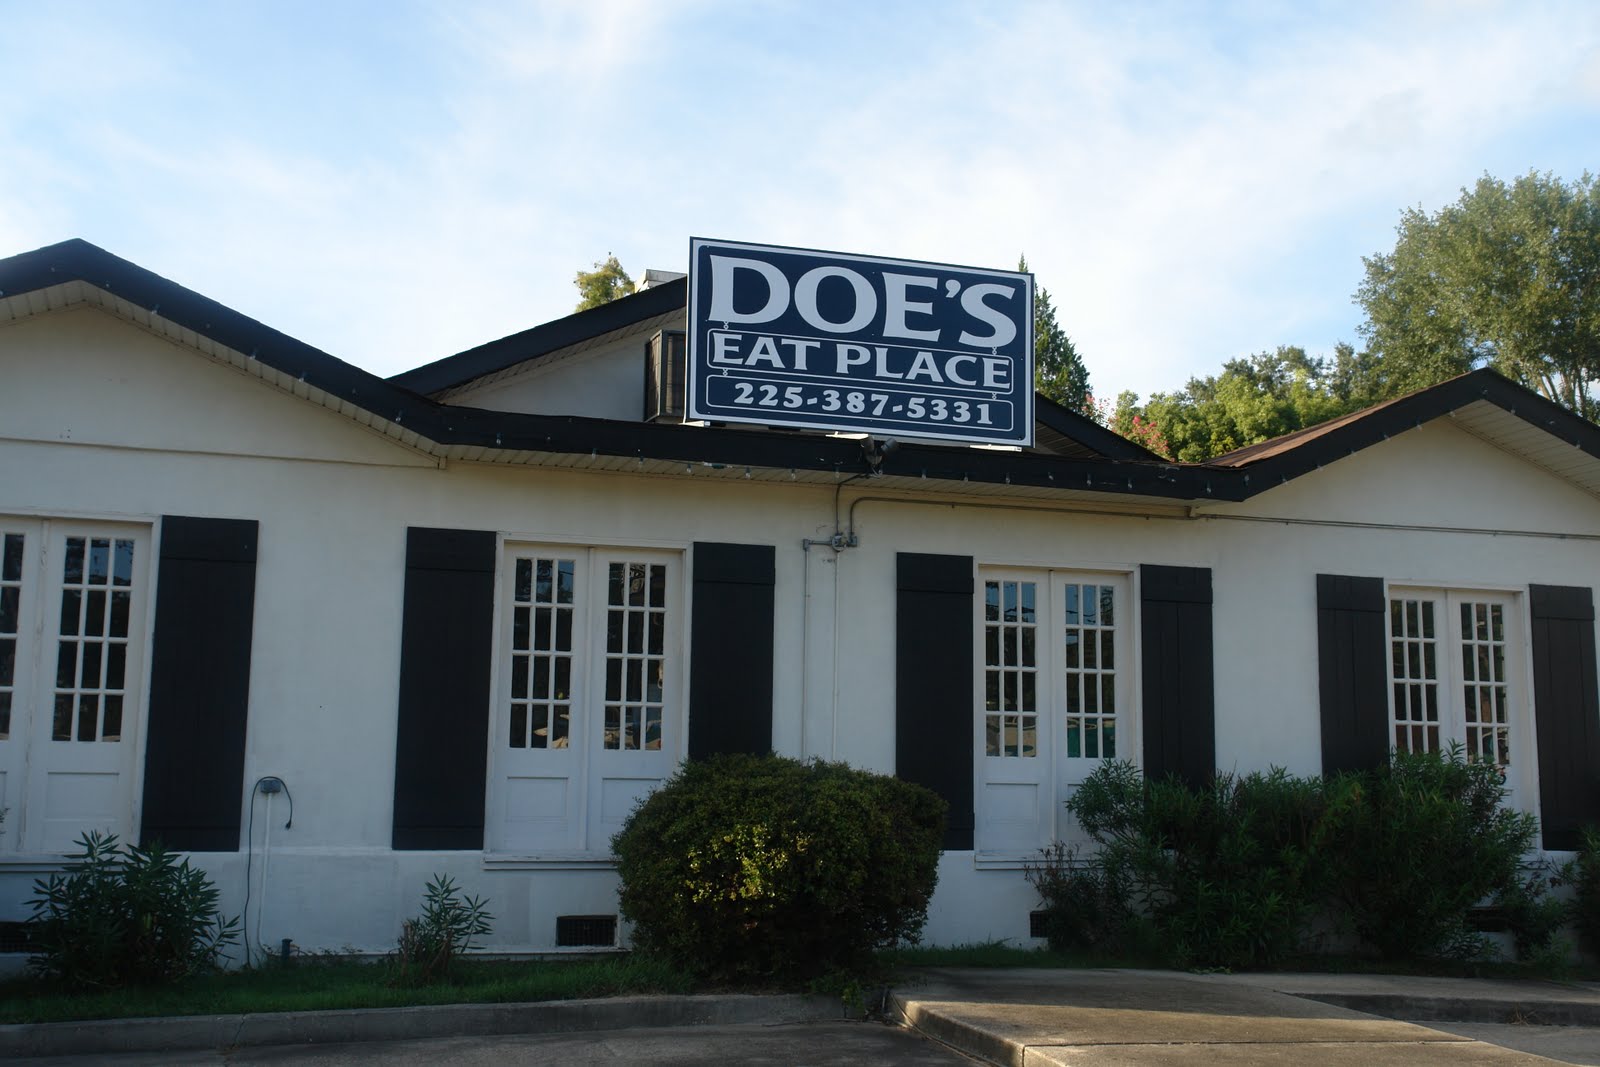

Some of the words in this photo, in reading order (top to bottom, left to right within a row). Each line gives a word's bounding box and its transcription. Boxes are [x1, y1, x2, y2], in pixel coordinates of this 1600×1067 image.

[708, 254, 1017, 348] DOE'S
[712, 332, 821, 371] EAT
[835, 343, 1011, 389] PLACE
[733, 382, 993, 425] 225-387-5331
